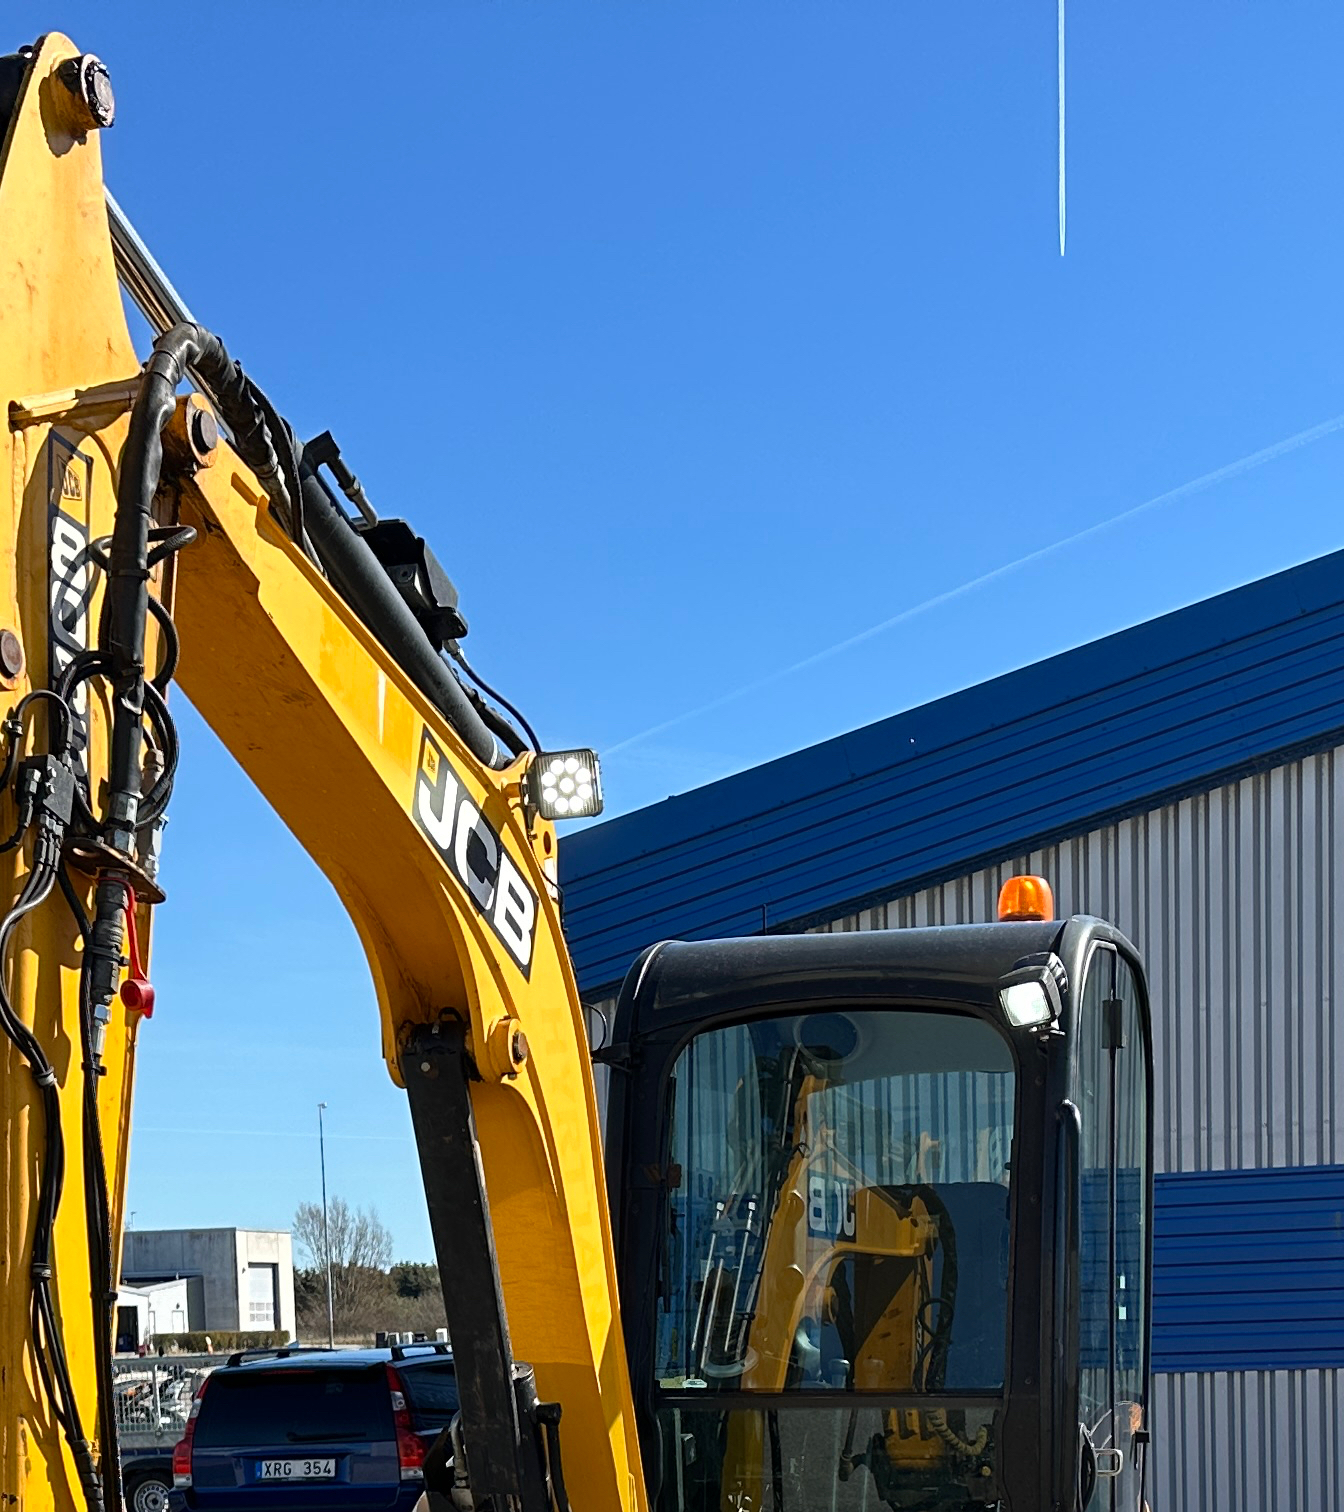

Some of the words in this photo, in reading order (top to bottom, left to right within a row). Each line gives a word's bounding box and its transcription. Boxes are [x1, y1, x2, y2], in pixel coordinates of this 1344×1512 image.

[418, 769, 535, 966] JCB
[264, 1461, 292, 1477] XRG
[303, 1460, 332, 1476] 354
